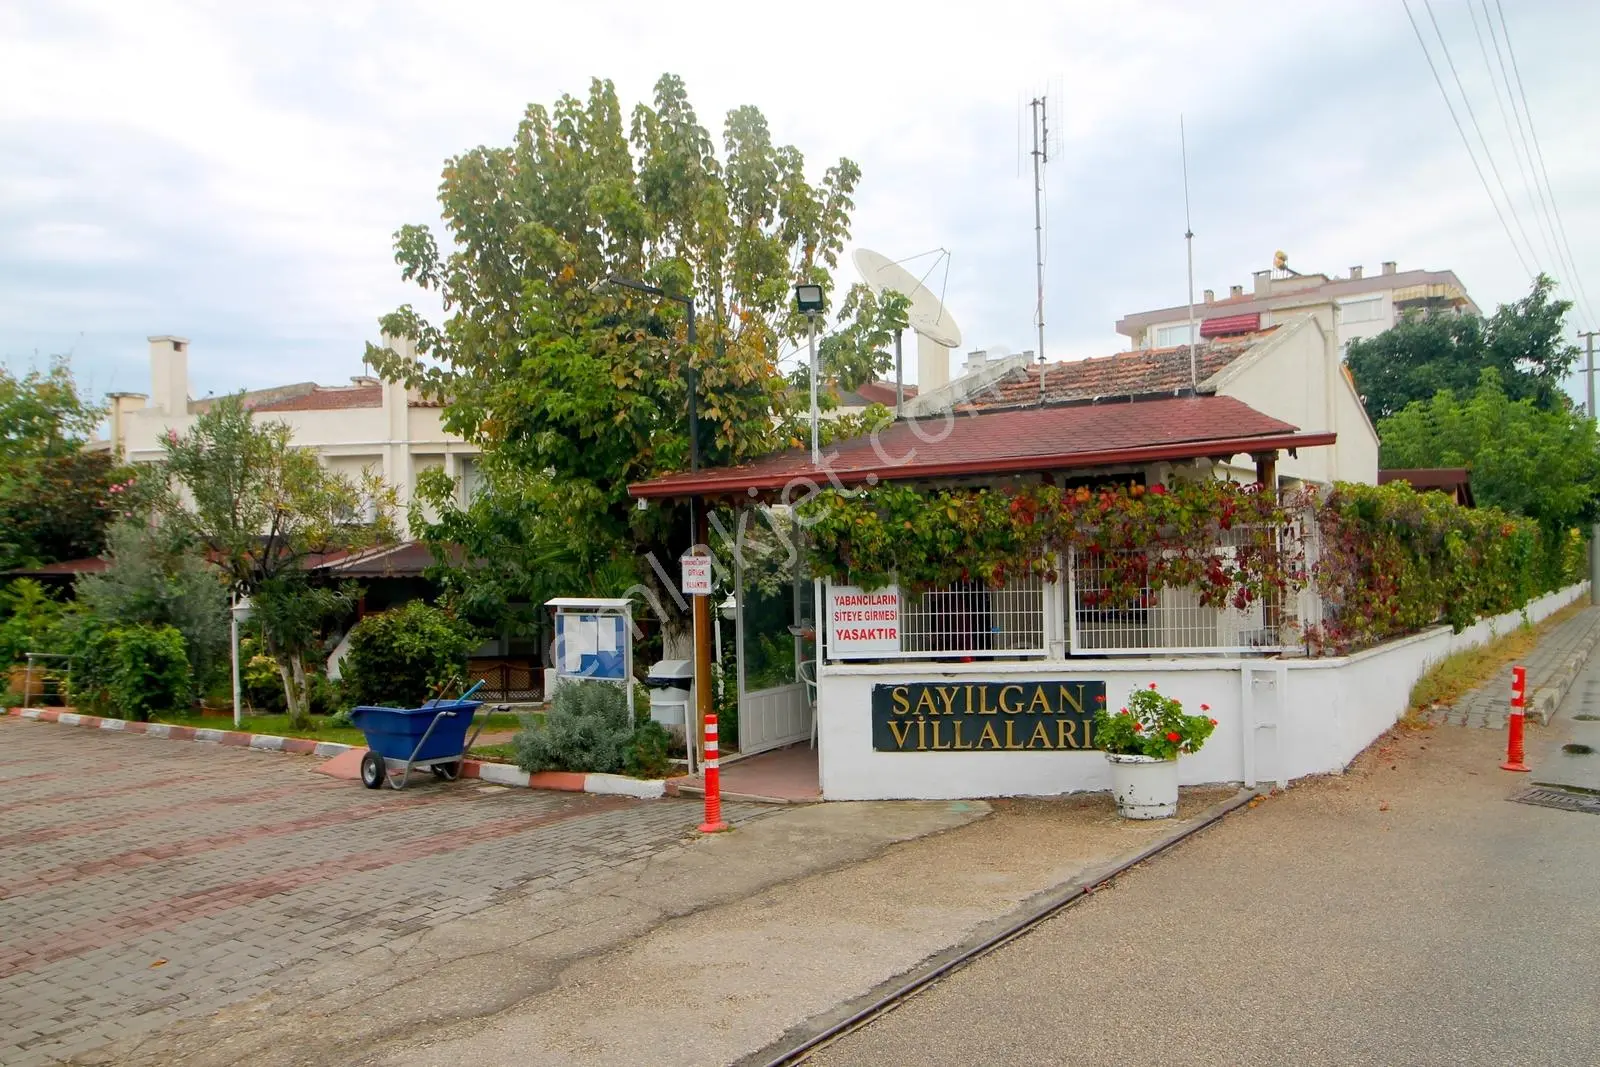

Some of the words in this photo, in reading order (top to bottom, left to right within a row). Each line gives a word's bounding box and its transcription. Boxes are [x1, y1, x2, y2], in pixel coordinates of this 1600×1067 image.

[834, 594, 897, 606] YABANCILARIN
[834, 609, 864, 622] SİTEYE
[864, 608, 898, 621] GİRMESİ
[836, 628, 897, 641] YASAKTIR
[891, 684, 1086, 716] SAYILGAN
[887, 715, 1093, 750] VİLLALARI
